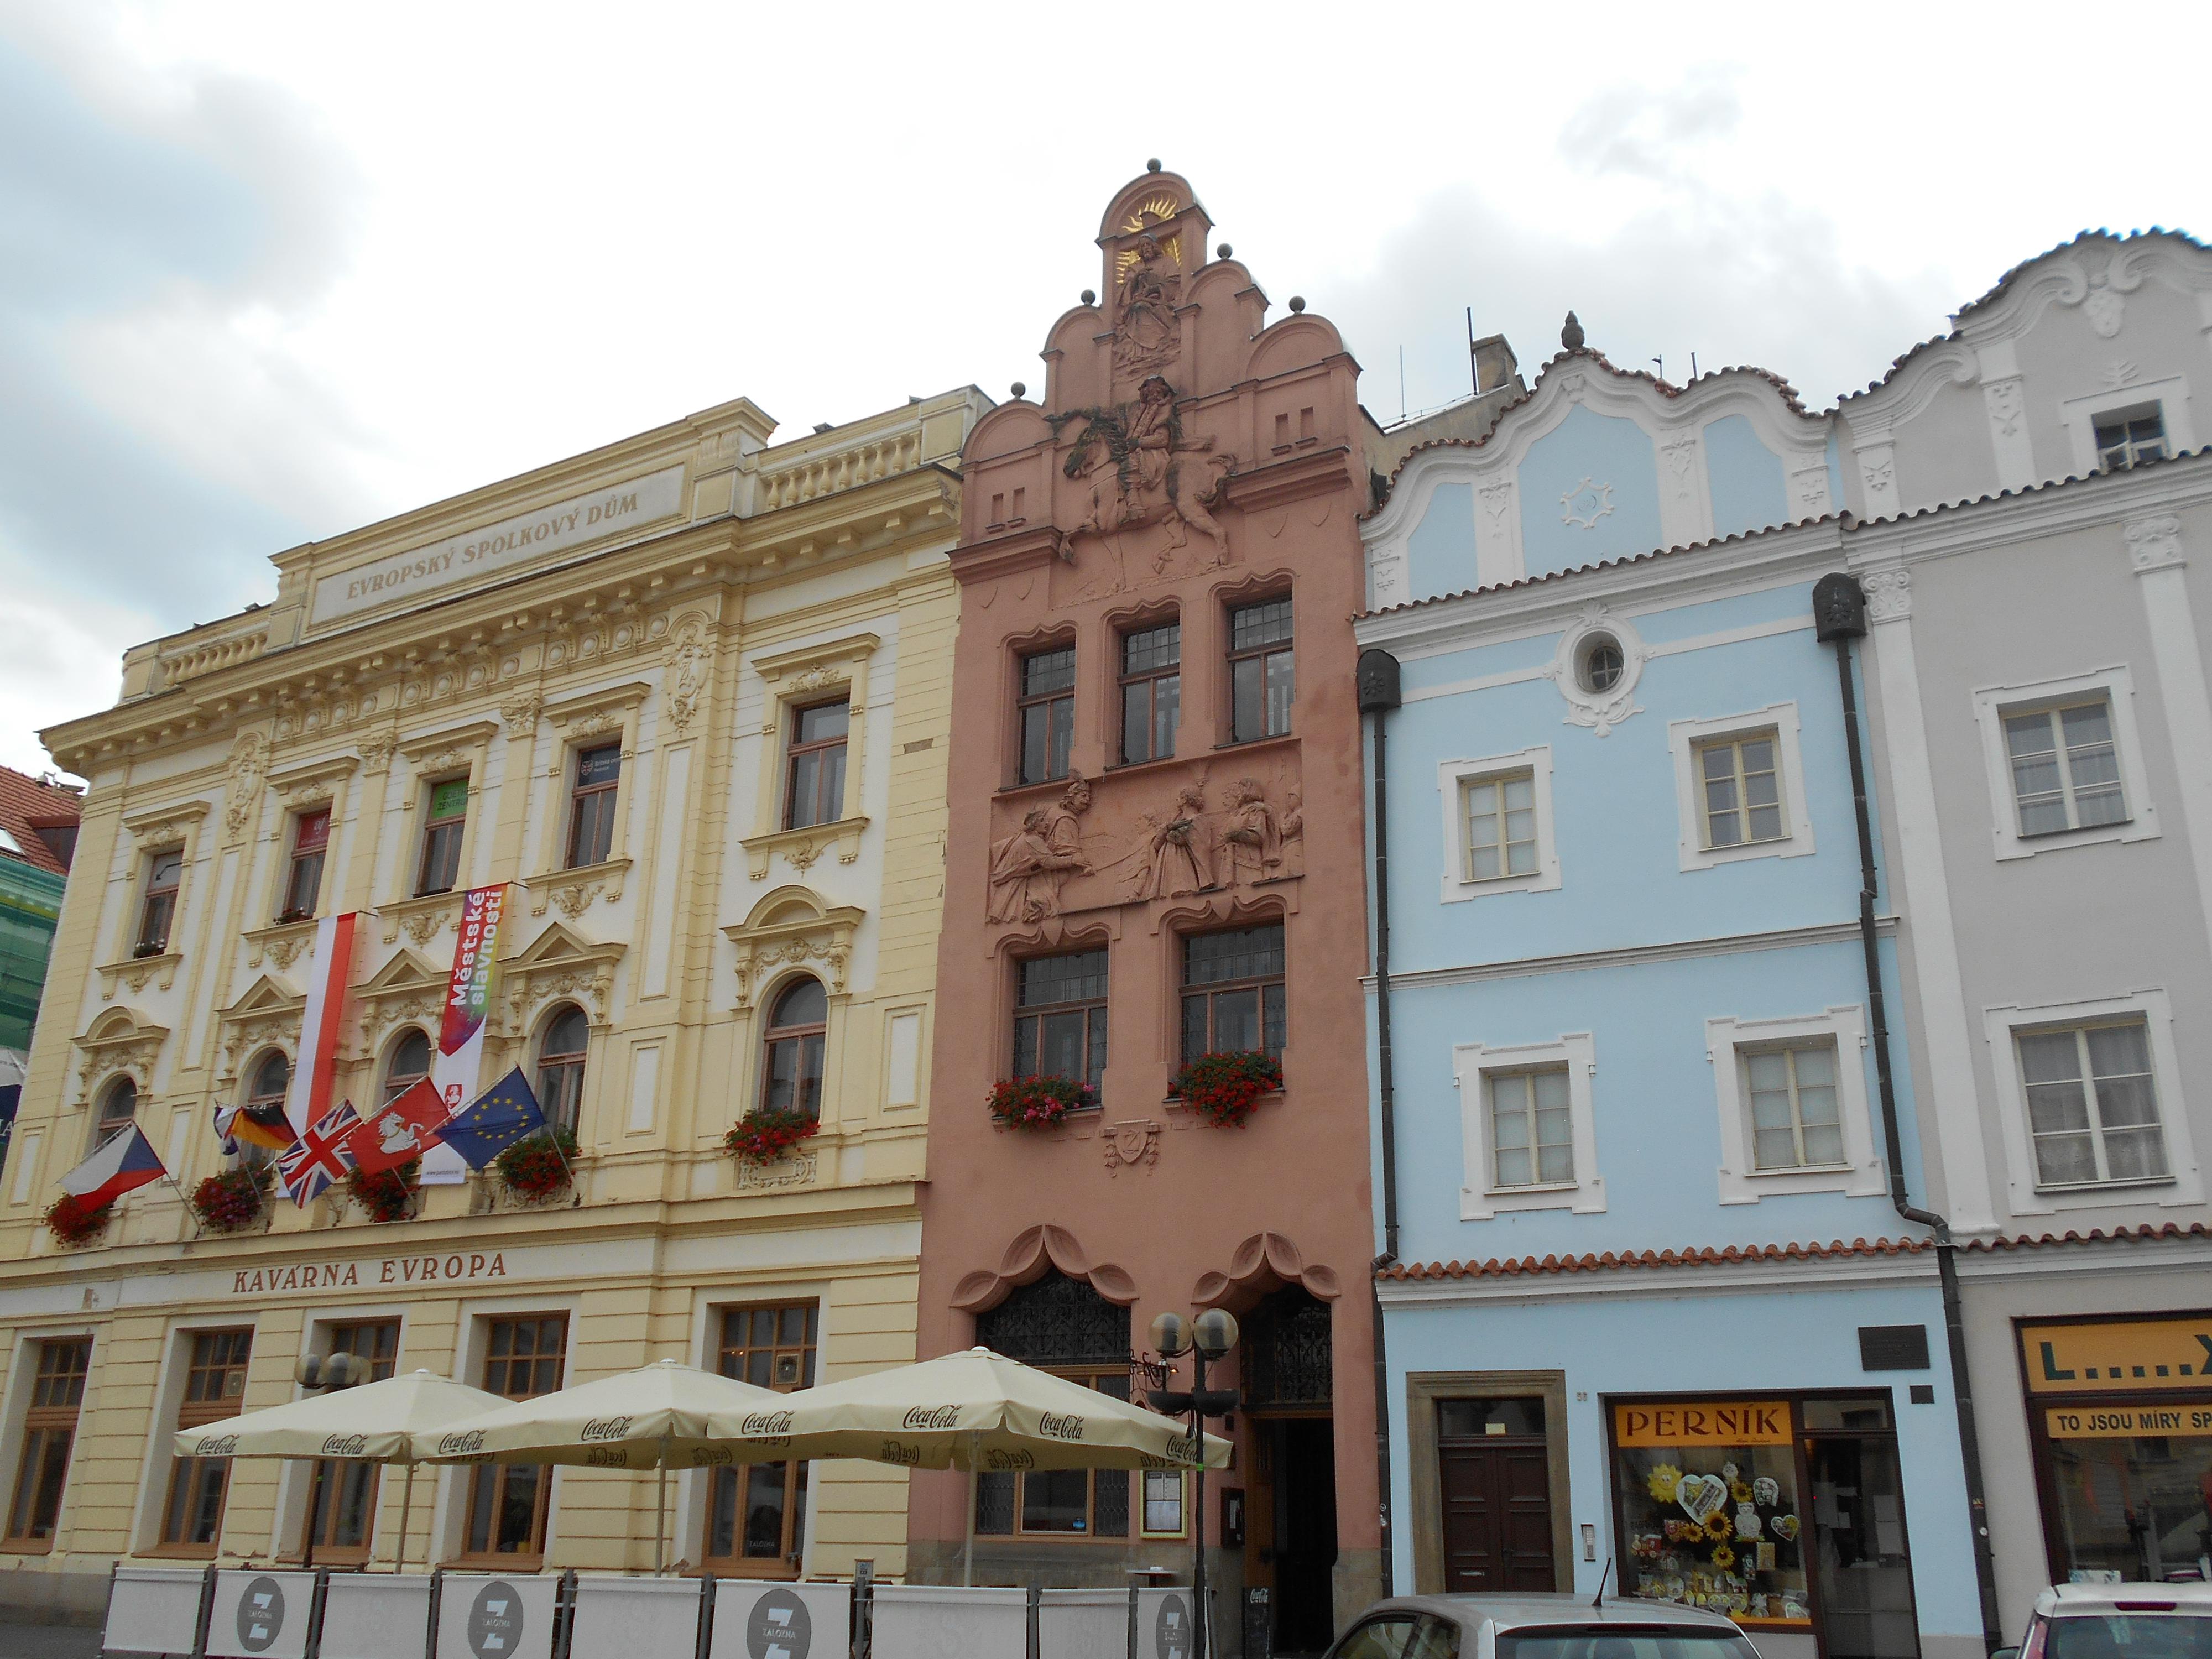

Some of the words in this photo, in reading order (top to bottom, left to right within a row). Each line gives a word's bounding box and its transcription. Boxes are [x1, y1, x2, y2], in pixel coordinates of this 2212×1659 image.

[346, 551, 455, 600] EVROPSKÝ
[461, 508, 581, 565] SPOLKOVÝ
[586, 492, 639, 526] DŮM
[450, 891, 485, 1005] Městské
[471, 891, 502, 1005] slavnosti
[232, 1264, 358, 1293] KAVÁRNA
[379, 1253, 506, 1283] EVROPA
[581, 1416, 635, 1441] Coca-Cola
[742, 1410, 796, 1434] Coca-Cola
[902, 1404, 964, 1430] Coca-Cola
[1039, 1411, 1084, 1440] Coca-Cola
[1627, 1403, 1780, 1436] PERNÍK
[2057, 1415, 2080, 1431] TO
[2088, 1414, 2132, 1431] JSOU
[2140, 1410, 2182, 1429] MÍRY
[196, 1434, 241, 1455] Coca-Cola
[322, 1434, 368, 1455] Coca-Cola
[439, 1430, 488, 1454] Coca-Cola
